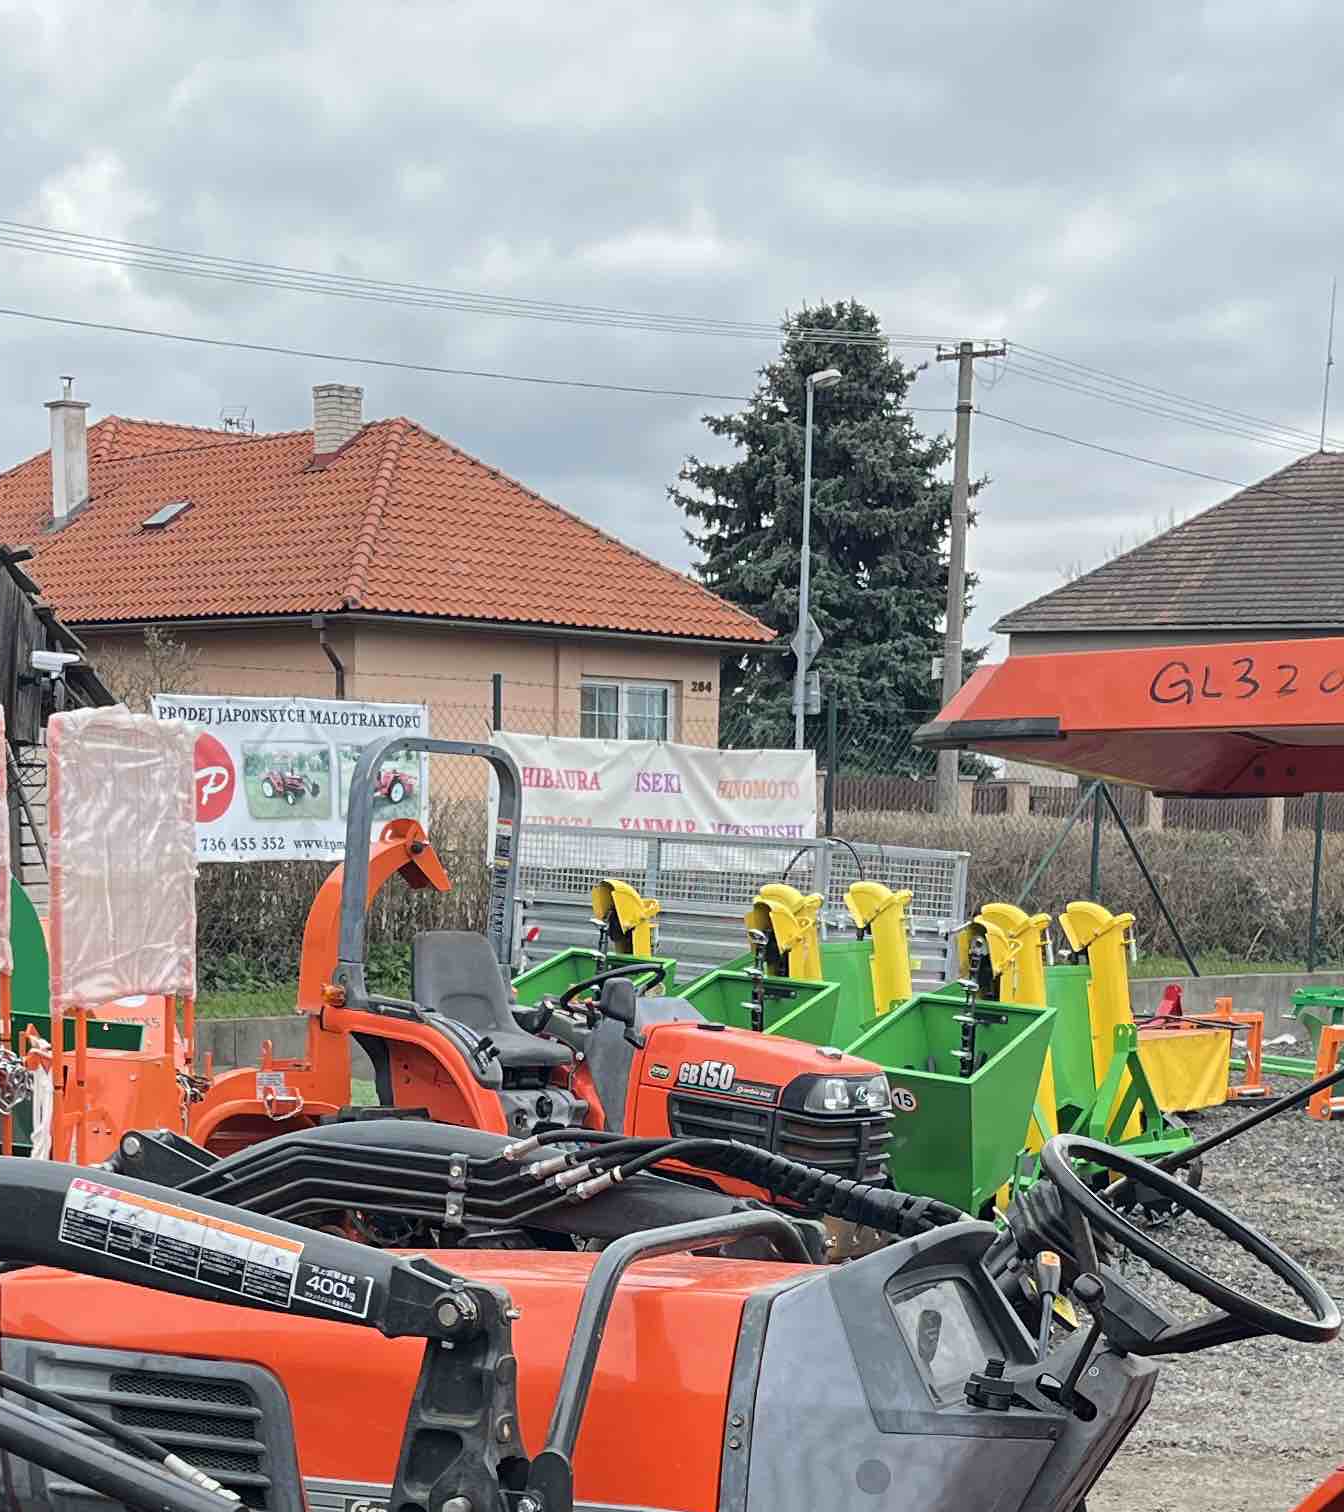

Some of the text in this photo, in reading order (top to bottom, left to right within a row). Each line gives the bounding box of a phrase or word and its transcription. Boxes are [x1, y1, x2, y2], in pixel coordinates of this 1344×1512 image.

[158, 705, 212, 725] PRODEJ
[521, 767, 800, 800] HIBAURA ISEKI HINOMOTO
[200, 837, 227, 851] 736
[230, 836, 256, 850] 455
[261, 836, 286, 850] 352
[678, 1060, 736, 1091] GB150
[893, 1092, 915, 1108] 15
